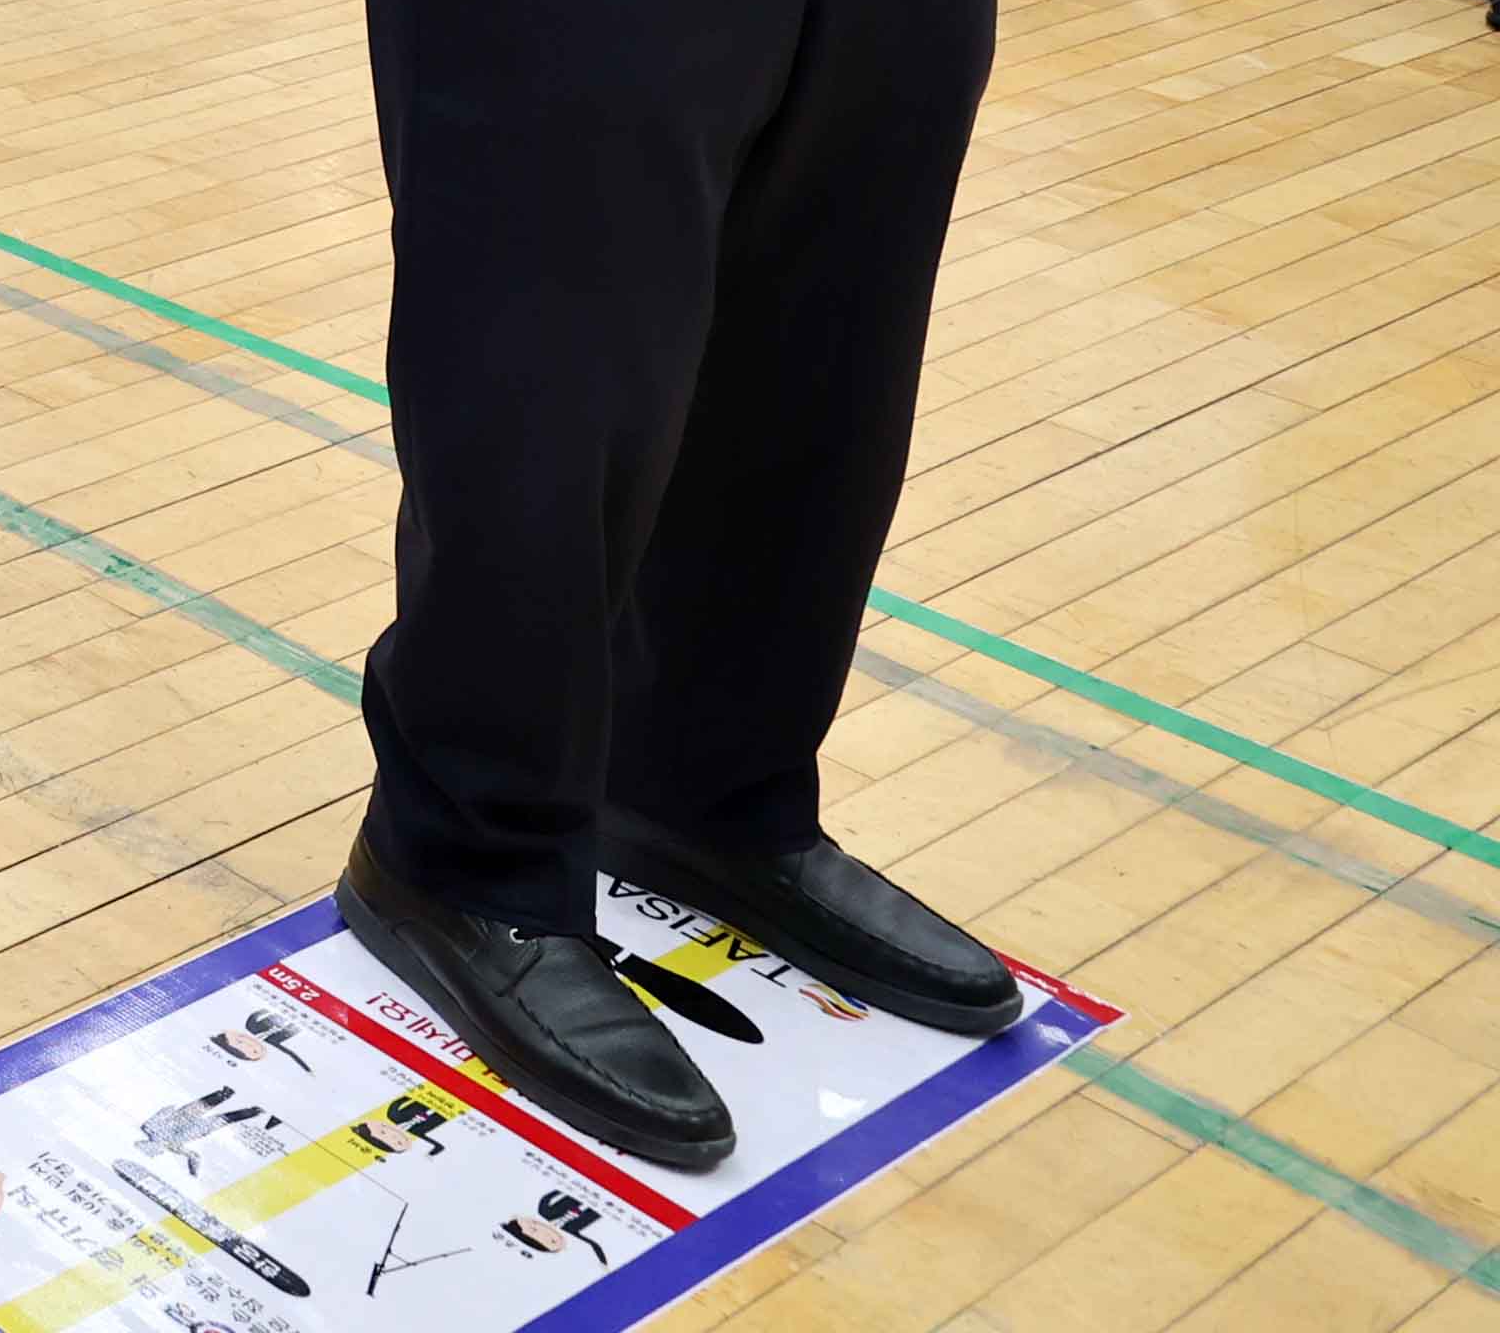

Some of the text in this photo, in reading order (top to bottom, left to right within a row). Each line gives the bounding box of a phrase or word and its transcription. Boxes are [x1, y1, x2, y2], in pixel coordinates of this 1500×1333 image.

[605, 874, 791, 989] TAFISA
[267, 967, 323, 1003] 2.5m
[227, 1241, 287, 1280] 한궁
